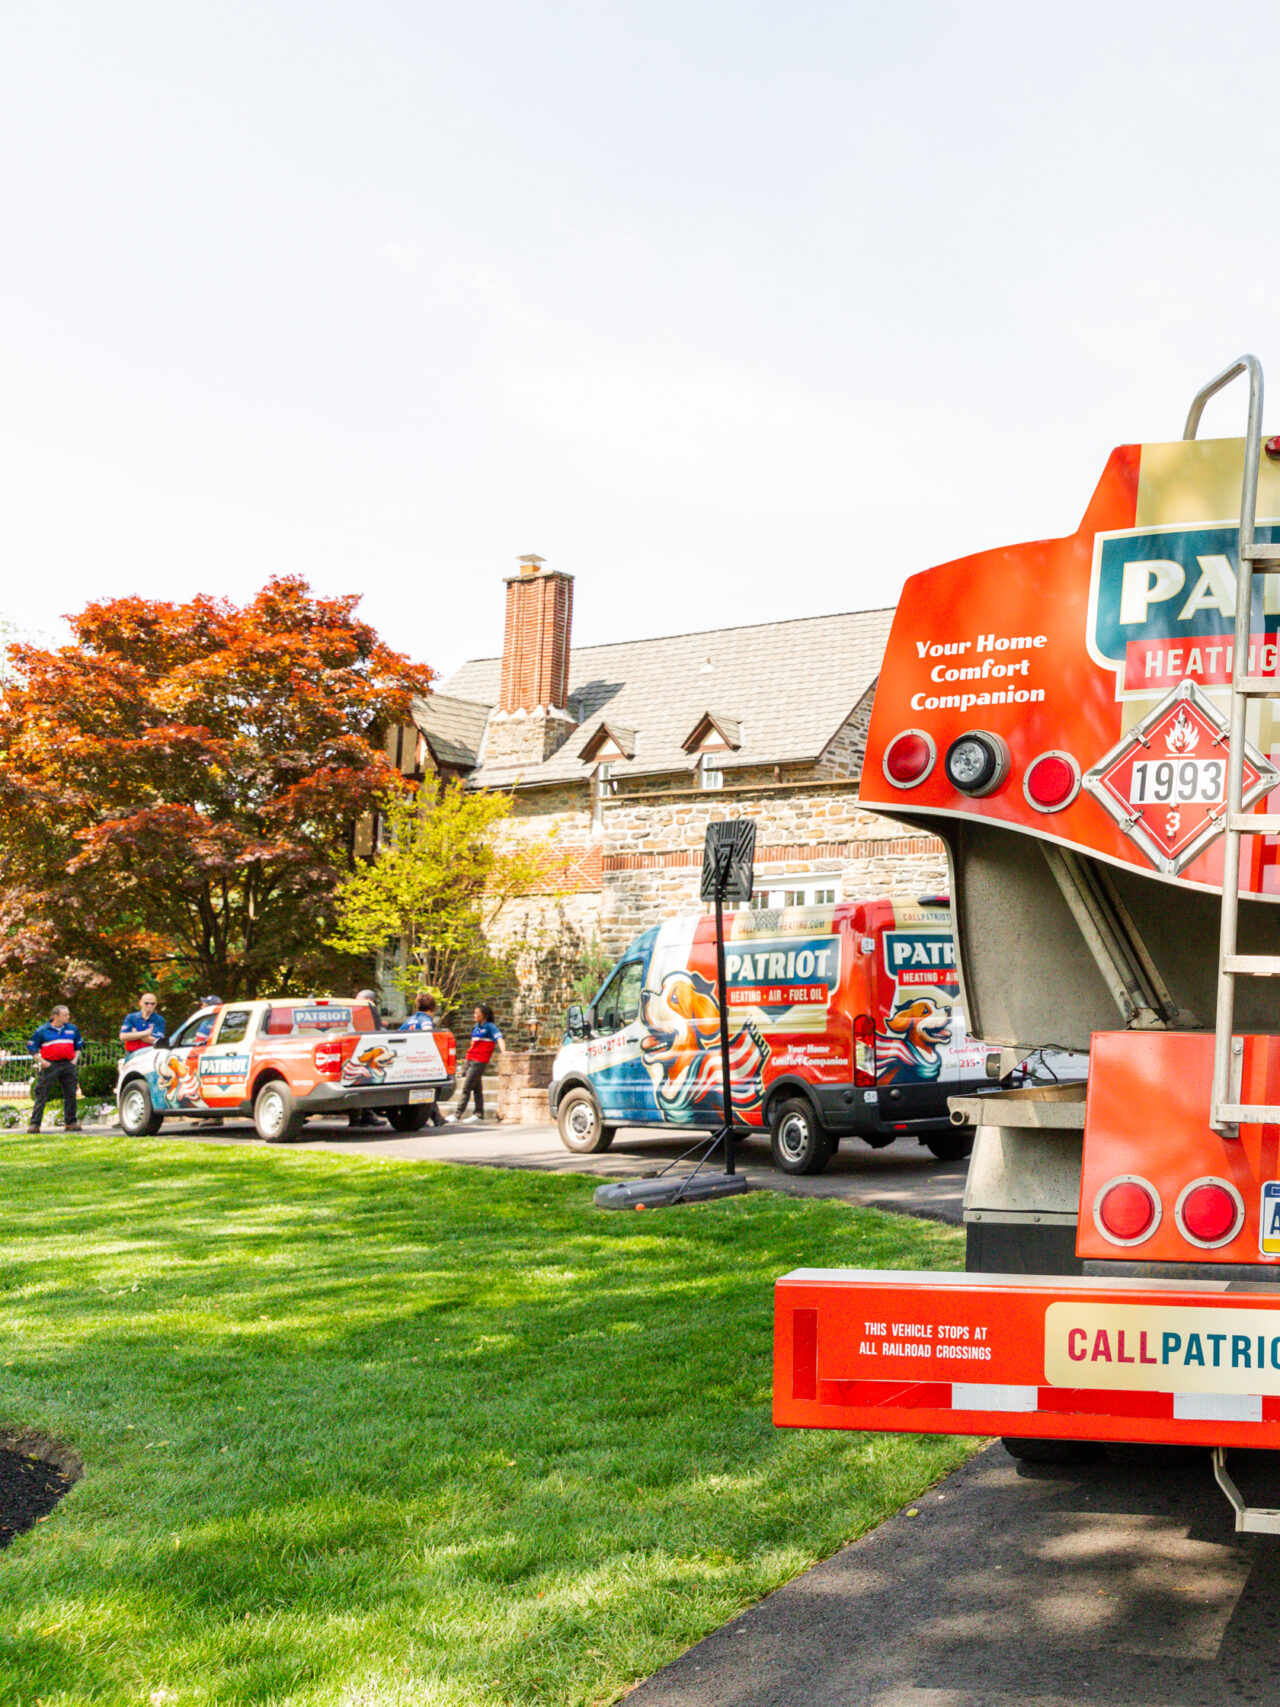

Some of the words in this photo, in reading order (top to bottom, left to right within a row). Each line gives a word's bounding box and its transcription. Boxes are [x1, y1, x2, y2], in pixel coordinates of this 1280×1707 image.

[916, 640, 972, 659] Your
[976, 634, 1048, 653] Home
[930, 658, 1031, 683] Comfort
[910, 685, 1046, 712] Companion
[1136, 761, 1222, 801] 1993
[1165, 811, 1180, 832] 3
[893, 942, 956, 965] PATR
[725, 949, 831, 981] PATRIOT
[903, 972, 938, 983] HEATING
[945, 972, 958, 982] AIR
[730, 990, 761, 1004] HEATING
[768, 989, 782, 1001] AIR
[789, 988, 808, 1001] FUEL
[810, 988, 823, 1000] OIL
[296, 1011, 348, 1021] PATRIOT
[787, 1044, 806, 1054] Your
[806, 1044, 831, 1053] Home
[201, 1059, 248, 1074] PATRIOT
[771, 1055, 802, 1066] Comfort
[802, 1056, 849, 1068] Companion
[864, 1322, 887, 1336] THIS
[891, 1323, 933, 1338] VEHICLE
[938, 1325, 969, 1339] STOPS
[974, 1327, 987, 1340] AT
[859, 1341, 877, 1355] ALL
[882, 1342, 931, 1357] RAILROAD
[936, 1345, 992, 1360] CROSSINGS
